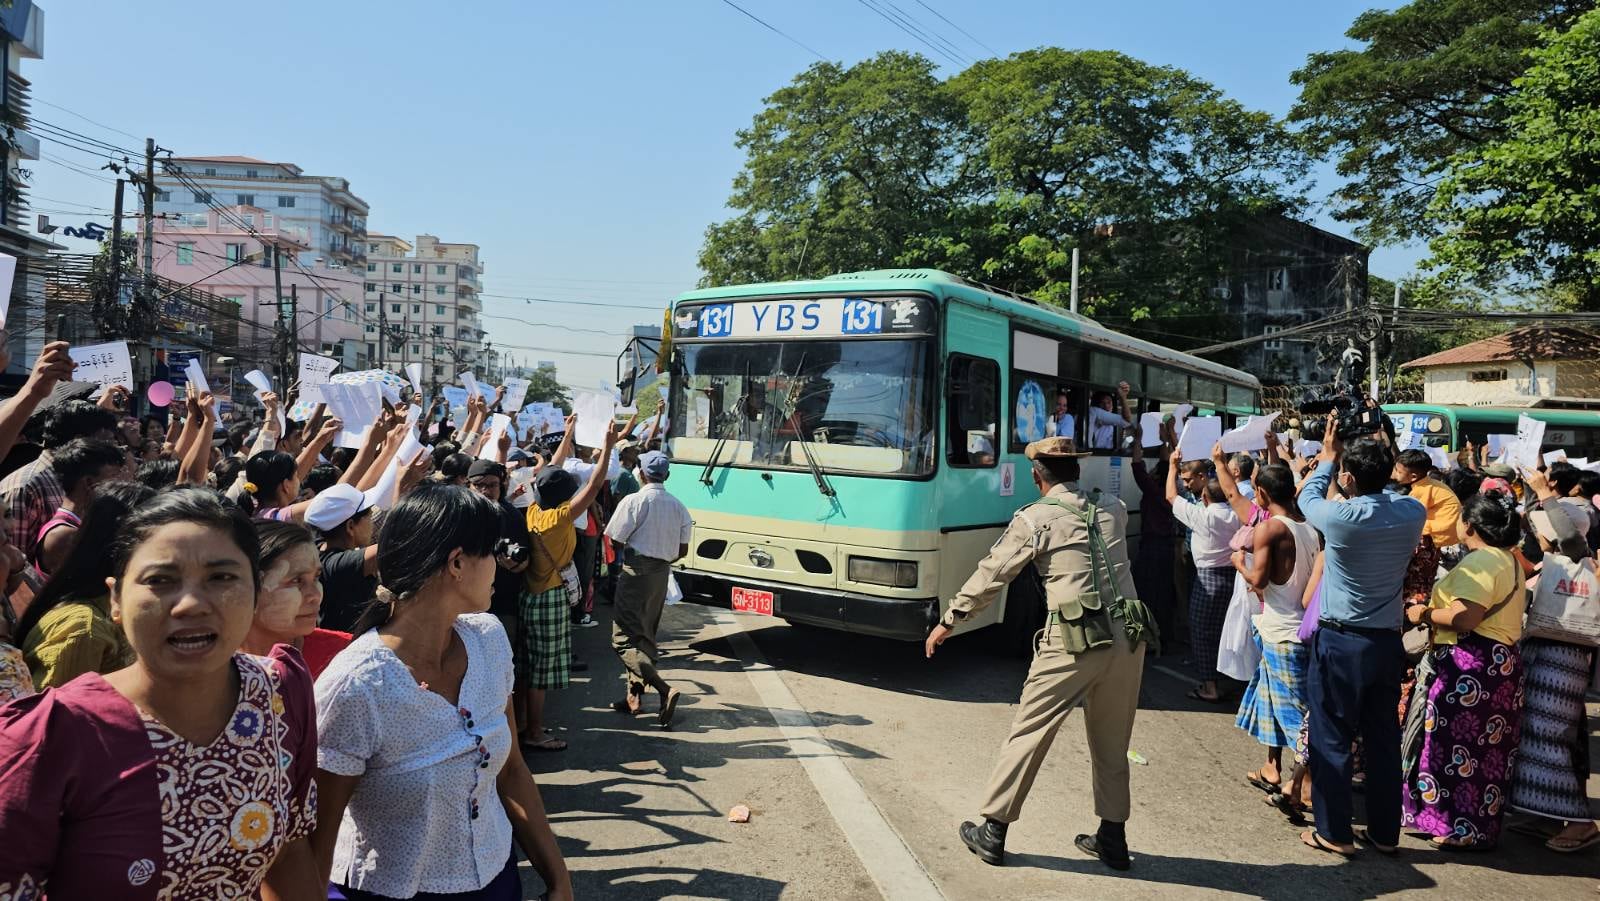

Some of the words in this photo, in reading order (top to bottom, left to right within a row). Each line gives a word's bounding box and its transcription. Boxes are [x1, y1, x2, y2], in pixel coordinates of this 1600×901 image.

[700, 304, 732, 336] 131
[752, 303, 821, 331] YBS
[844, 301, 882, 331] 131
[1413, 417, 1428, 430] 131
[734, 593, 770, 610] 5N-3113
